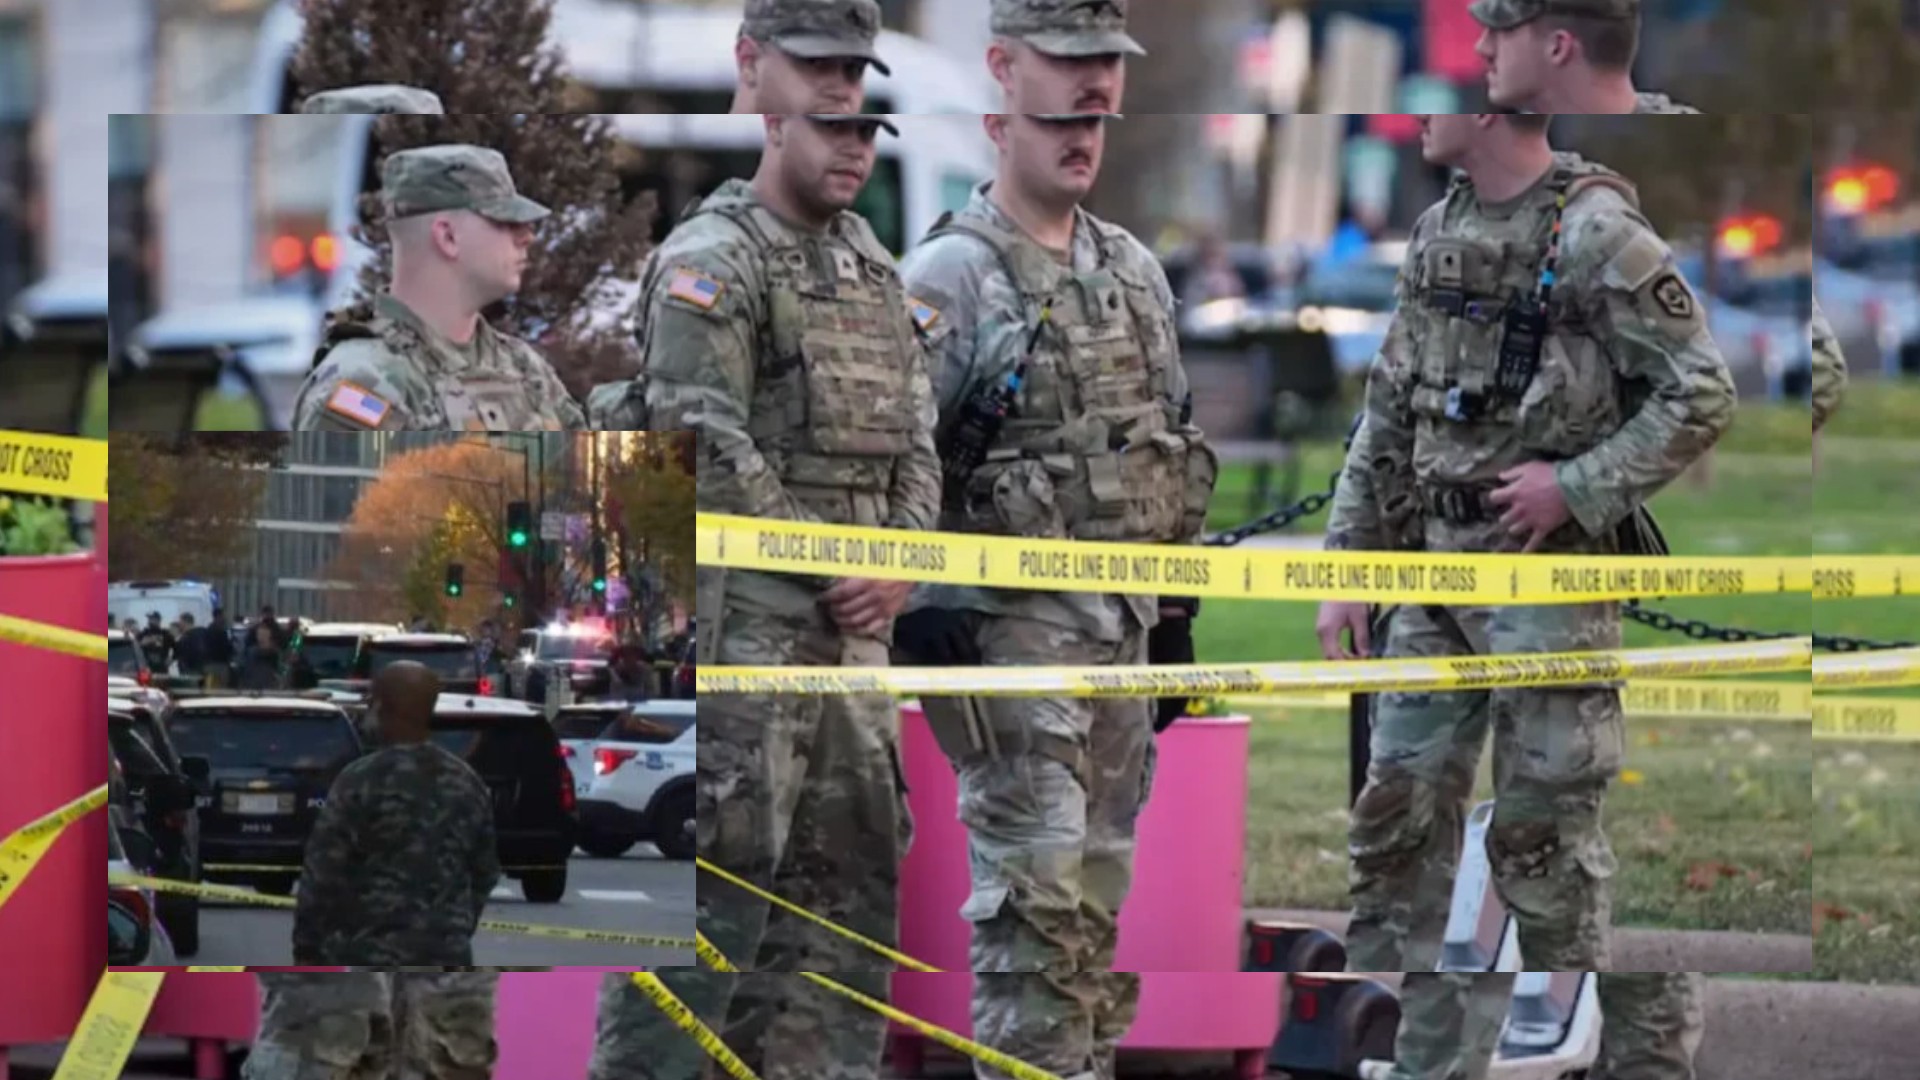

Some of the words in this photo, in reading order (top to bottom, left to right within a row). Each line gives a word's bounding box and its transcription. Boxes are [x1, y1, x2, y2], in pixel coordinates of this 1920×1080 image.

[22, 446, 73, 481] CROSS
[758, 530, 807, 560] POLICE
[811, 533, 841, 563] LINE
[845, 537, 864, 565] DO
[868, 539, 896, 567] NOT
[900, 541, 946, 571] CROSS
[1019, 550, 1069, 578] POLICE
[1073, 553, 1104, 580] LINE
[1109, 555, 1128, 582] DO
[1132, 556, 1160, 582] NOT
[1164, 557, 1210, 585] CROSS
[1285, 561, 1334, 589] POLICE
[1338, 563, 1370, 589] LINE
[1374, 564, 1393, 590] DO
[1398, 565, 1425, 590] NOT
[1430, 565, 1476, 592] CROSS
[1552, 567, 1601, 592] POLICE
[1606, 568, 1636, 592] LINE
[1641, 569, 1660, 592] DO
[1665, 569, 1692, 592] NOT
[1698, 569, 1743, 593] CROSS
